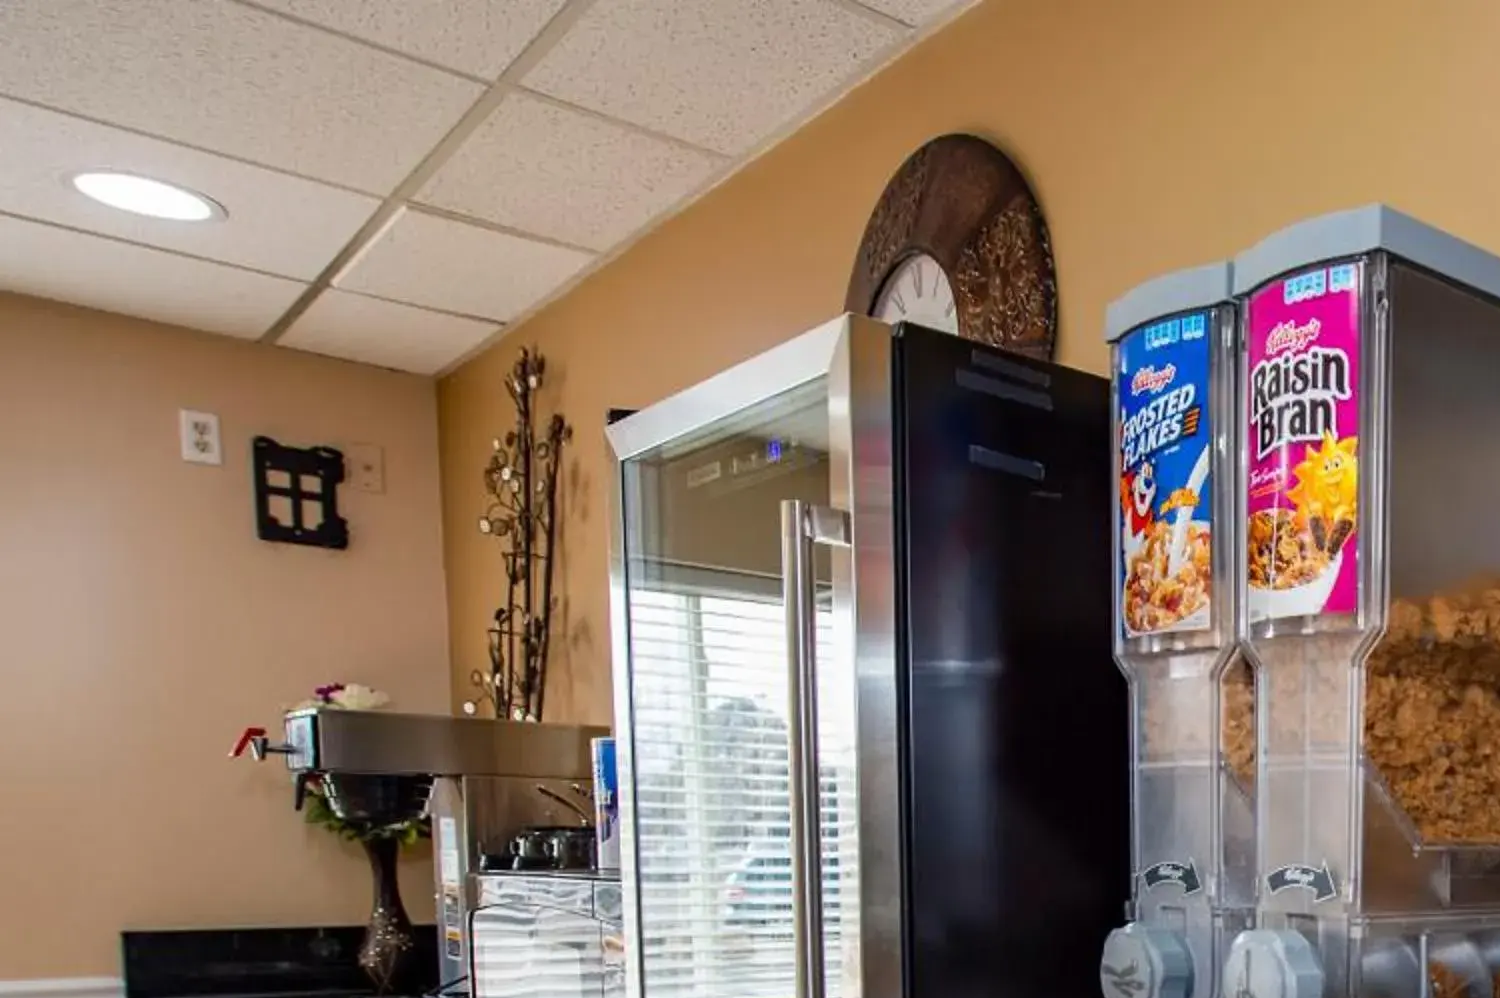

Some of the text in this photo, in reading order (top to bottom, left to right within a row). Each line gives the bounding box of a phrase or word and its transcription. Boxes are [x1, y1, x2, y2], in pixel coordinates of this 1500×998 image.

[1252, 349, 1347, 420] Raisin
[1122, 384, 1196, 449] FROSTED
[1122, 413, 1184, 472] FLAKES
[1260, 397, 1334, 455] Bran
